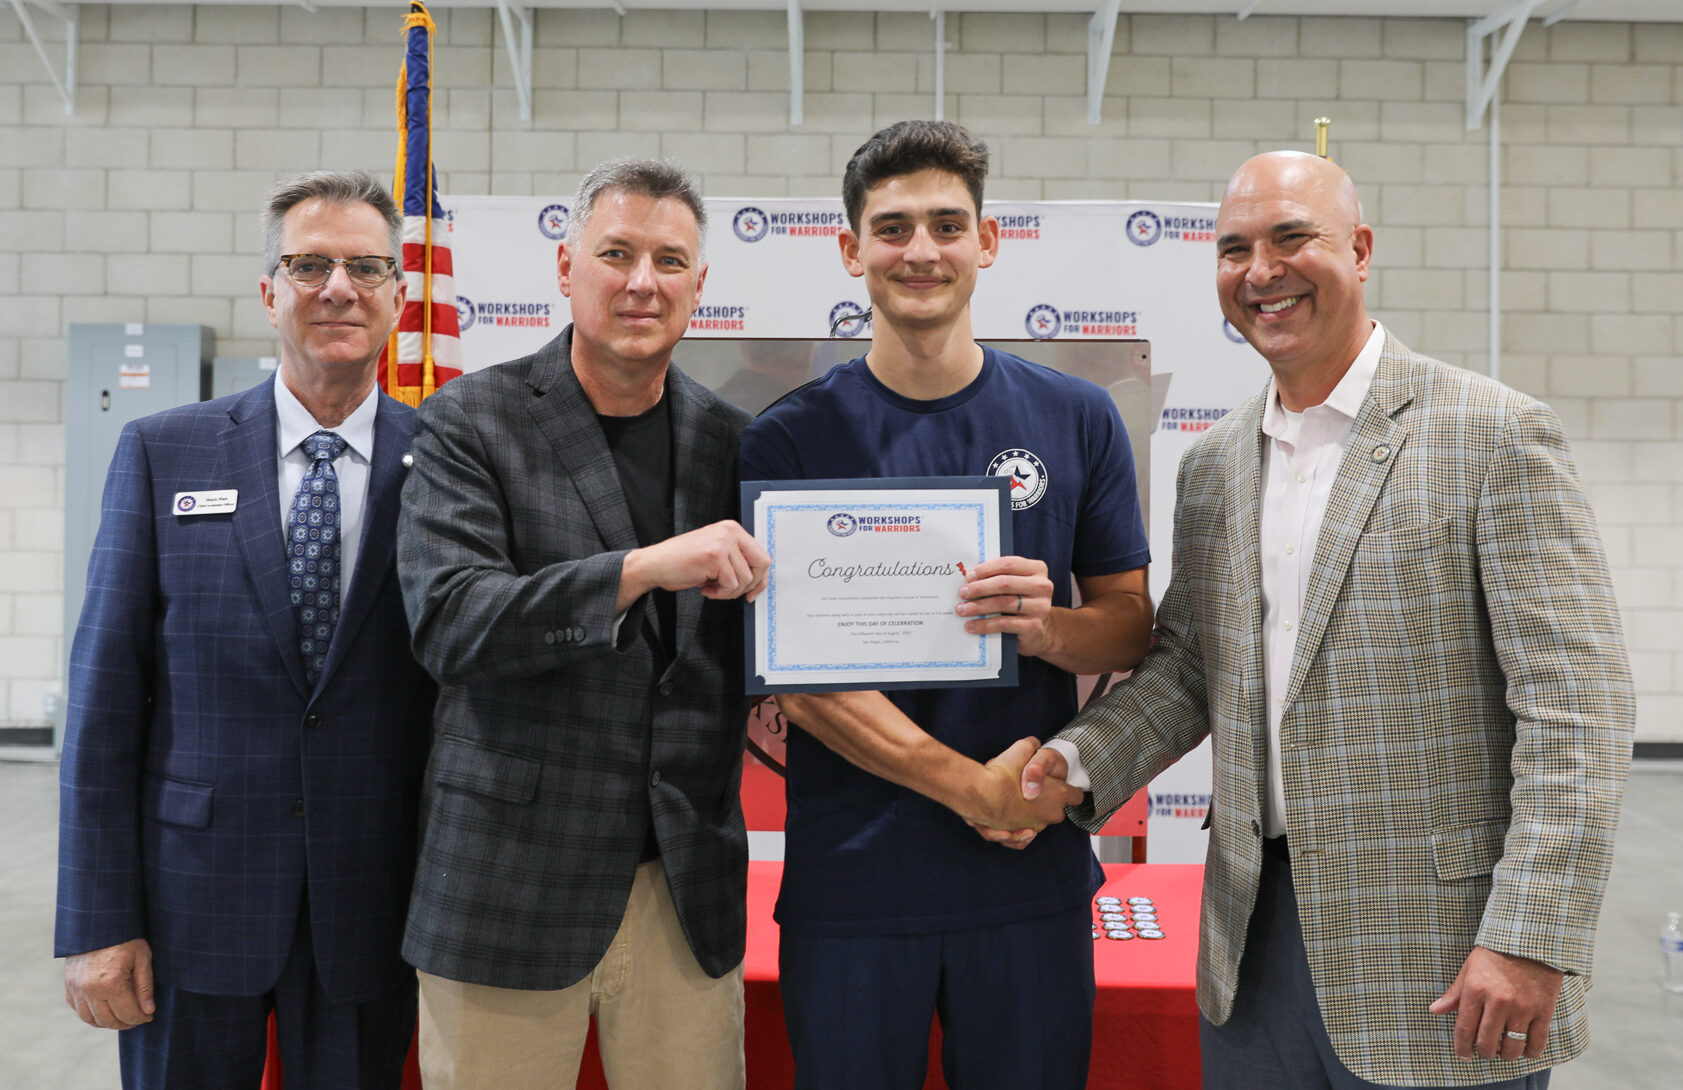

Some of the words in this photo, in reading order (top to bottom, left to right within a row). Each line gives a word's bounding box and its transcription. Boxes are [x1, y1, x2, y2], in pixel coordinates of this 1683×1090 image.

[770, 212, 844, 225] WORKSHOPS
[997, 215, 1040, 227] SHOPS
[1164, 217, 1217, 230] WORKSH
[771, 226, 788, 235] FOR
[1000, 229, 1040, 240] RRIORS
[1164, 231, 1180, 240] FOR
[478, 303, 551, 316] WORKSHOPS
[478, 316, 494, 325] FOR
[496, 316, 550, 328] WARRIORS
[1063, 311, 1137, 324] WORKSHOPS
[690, 319, 745, 331] WARRIORS
[1064, 325, 1080, 334] FOR
[1082, 325, 1137, 336] WARRIORS
[1162, 422, 1178, 430] FOR
[1015, 500, 1028, 509] FOR
[858, 516, 921, 525] WORKSHOPS
[874, 524, 921, 533] WARRIORS
[808, 557, 955, 583] Congratulations
[1156, 808, 1172, 816] FOR
